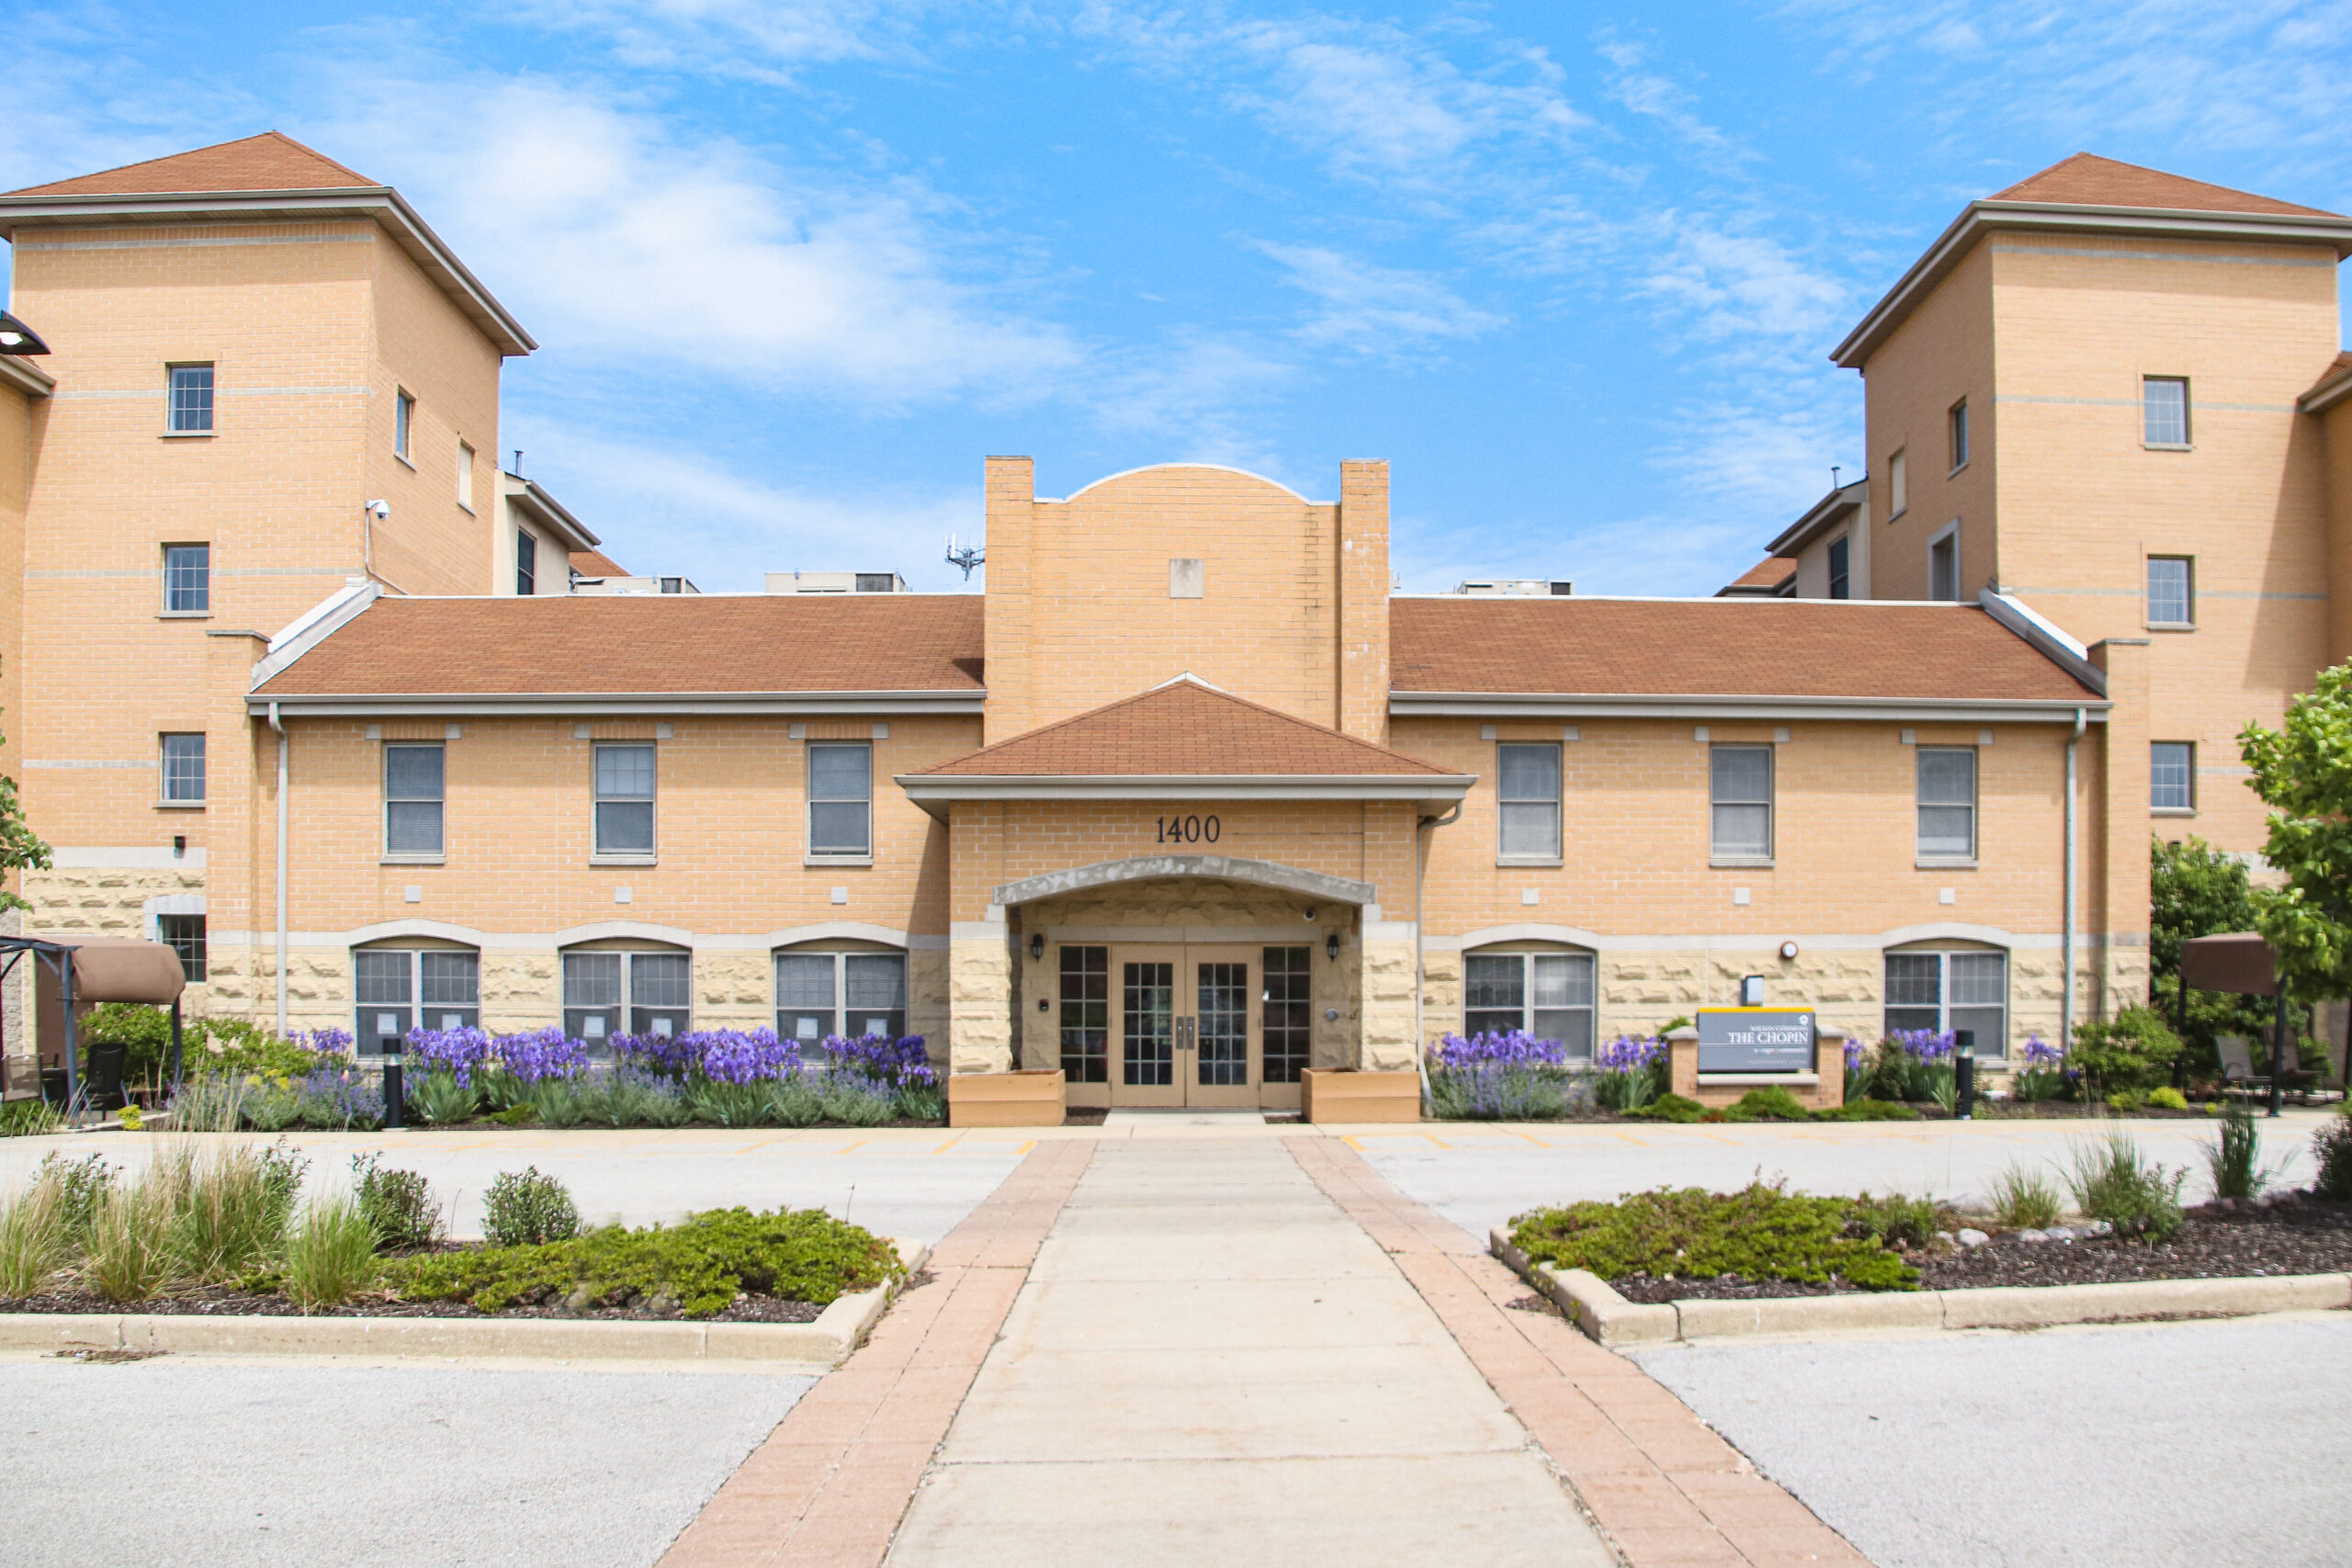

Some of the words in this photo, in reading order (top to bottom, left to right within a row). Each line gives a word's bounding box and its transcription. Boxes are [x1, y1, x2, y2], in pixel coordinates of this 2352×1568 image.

[1157, 815, 1220, 843] 1400
[1727, 1032, 1756, 1044] THE
[1758, 1032, 1808, 1044] CHOPIN
